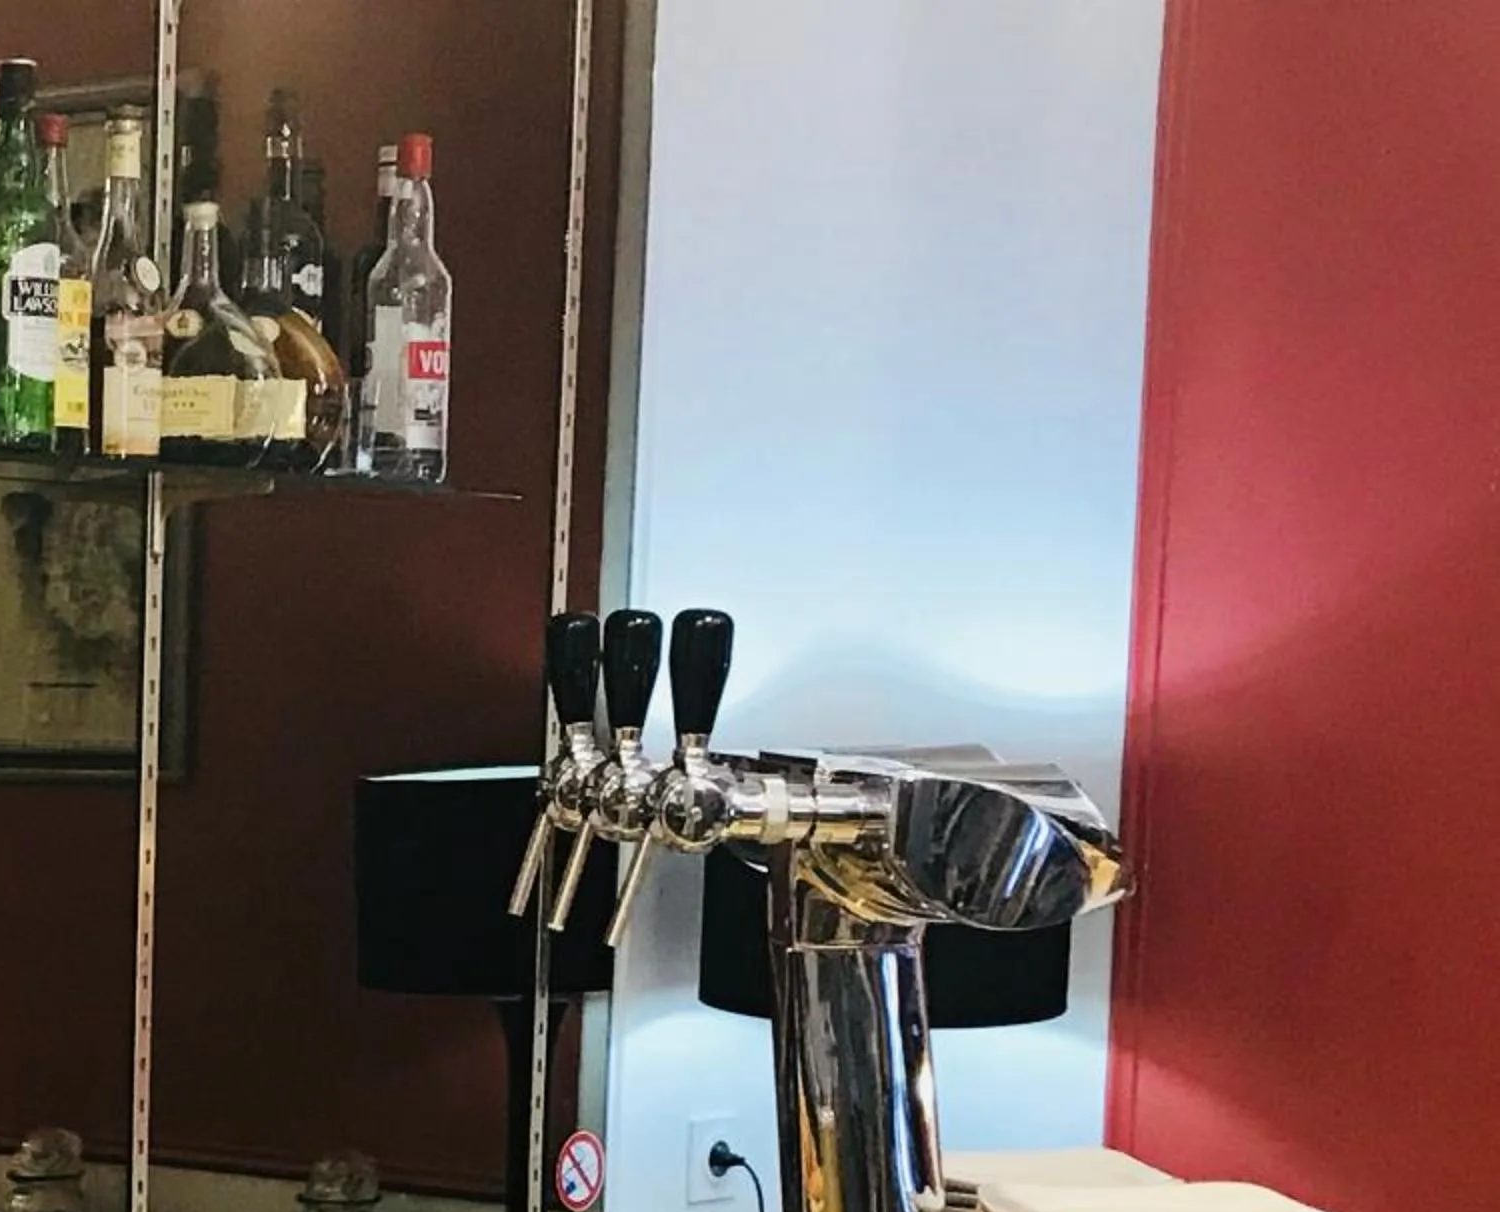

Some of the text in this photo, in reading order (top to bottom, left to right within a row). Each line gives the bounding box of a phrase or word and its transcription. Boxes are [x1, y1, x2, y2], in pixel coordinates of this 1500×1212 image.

[17, 280, 58, 296] WILLI
[13, 295, 58, 313] LAWSO
[419, 349, 446, 375] VO
